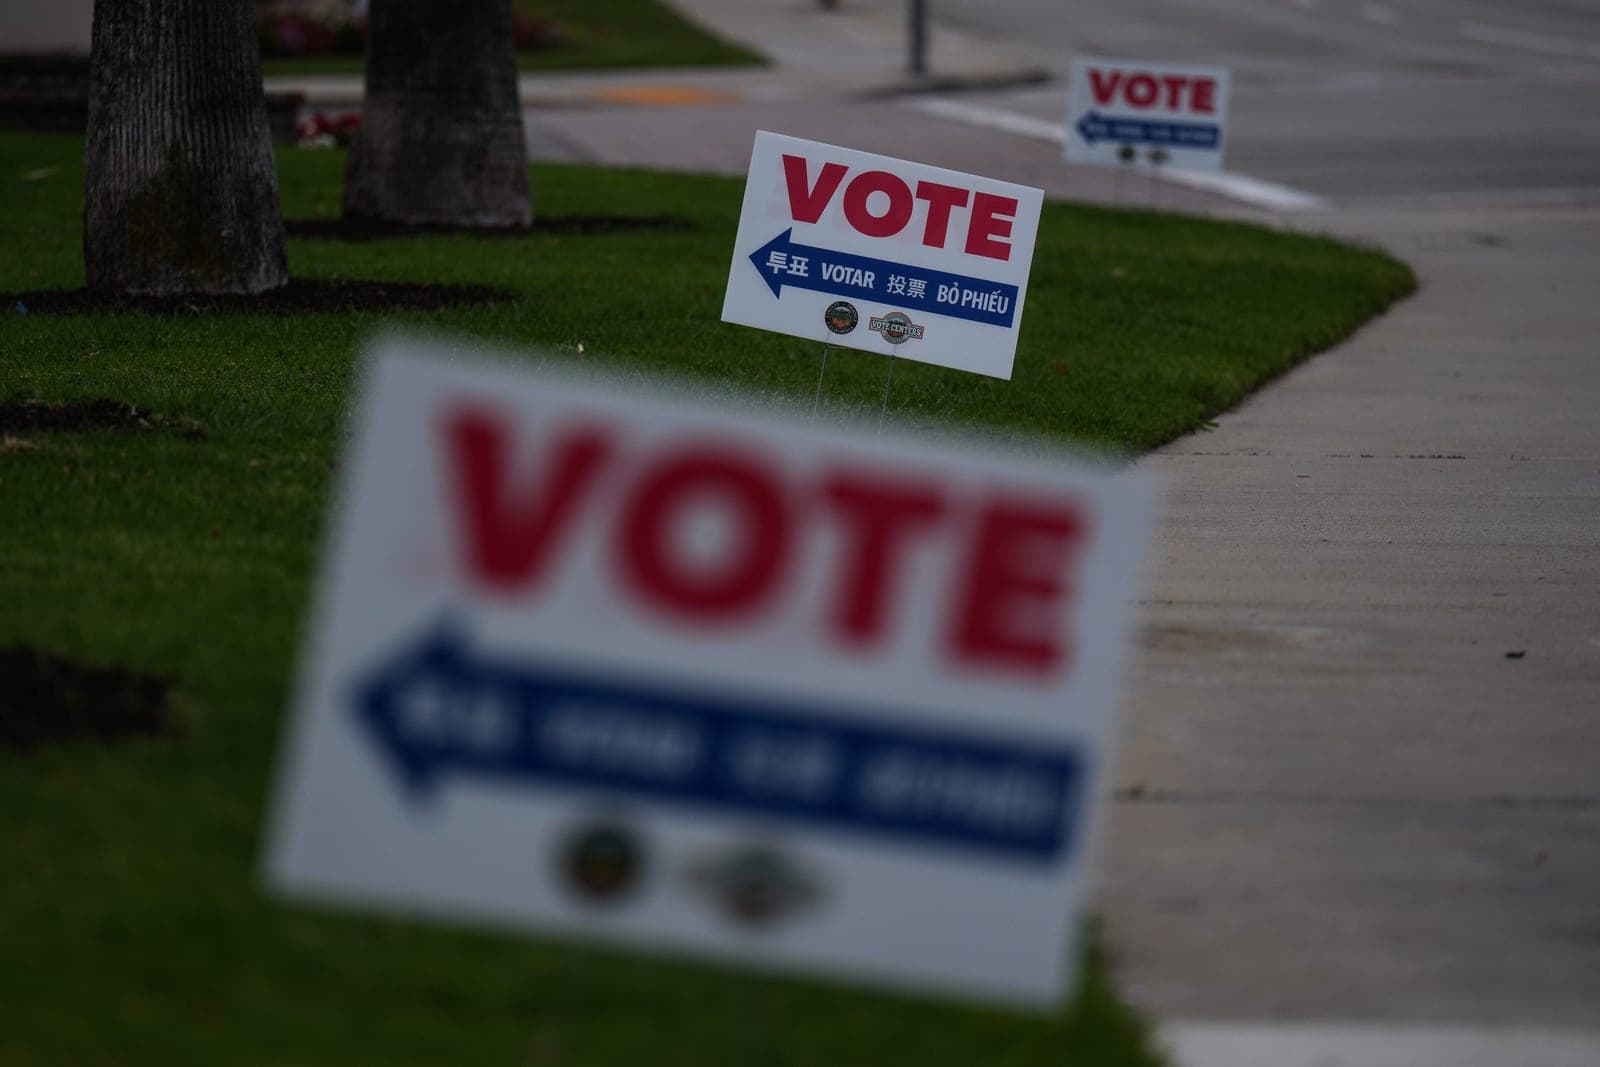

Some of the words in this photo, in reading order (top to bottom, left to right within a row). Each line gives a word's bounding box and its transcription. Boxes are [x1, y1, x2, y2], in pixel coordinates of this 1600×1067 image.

[1087, 68, 1217, 115] VOTE
[782, 154, 1018, 261] VOTE
[766, 251, 809, 277] 투표
[821, 262, 876, 289] VOTAR
[886, 274, 928, 299] 投票
[936, 281, 960, 304] BỎ
[961, 289, 1009, 314] PHIẾU
[871, 319, 891, 331] VOTE
[891, 323, 923, 337] CENTERS
[436, 396, 1094, 682] VOTE
